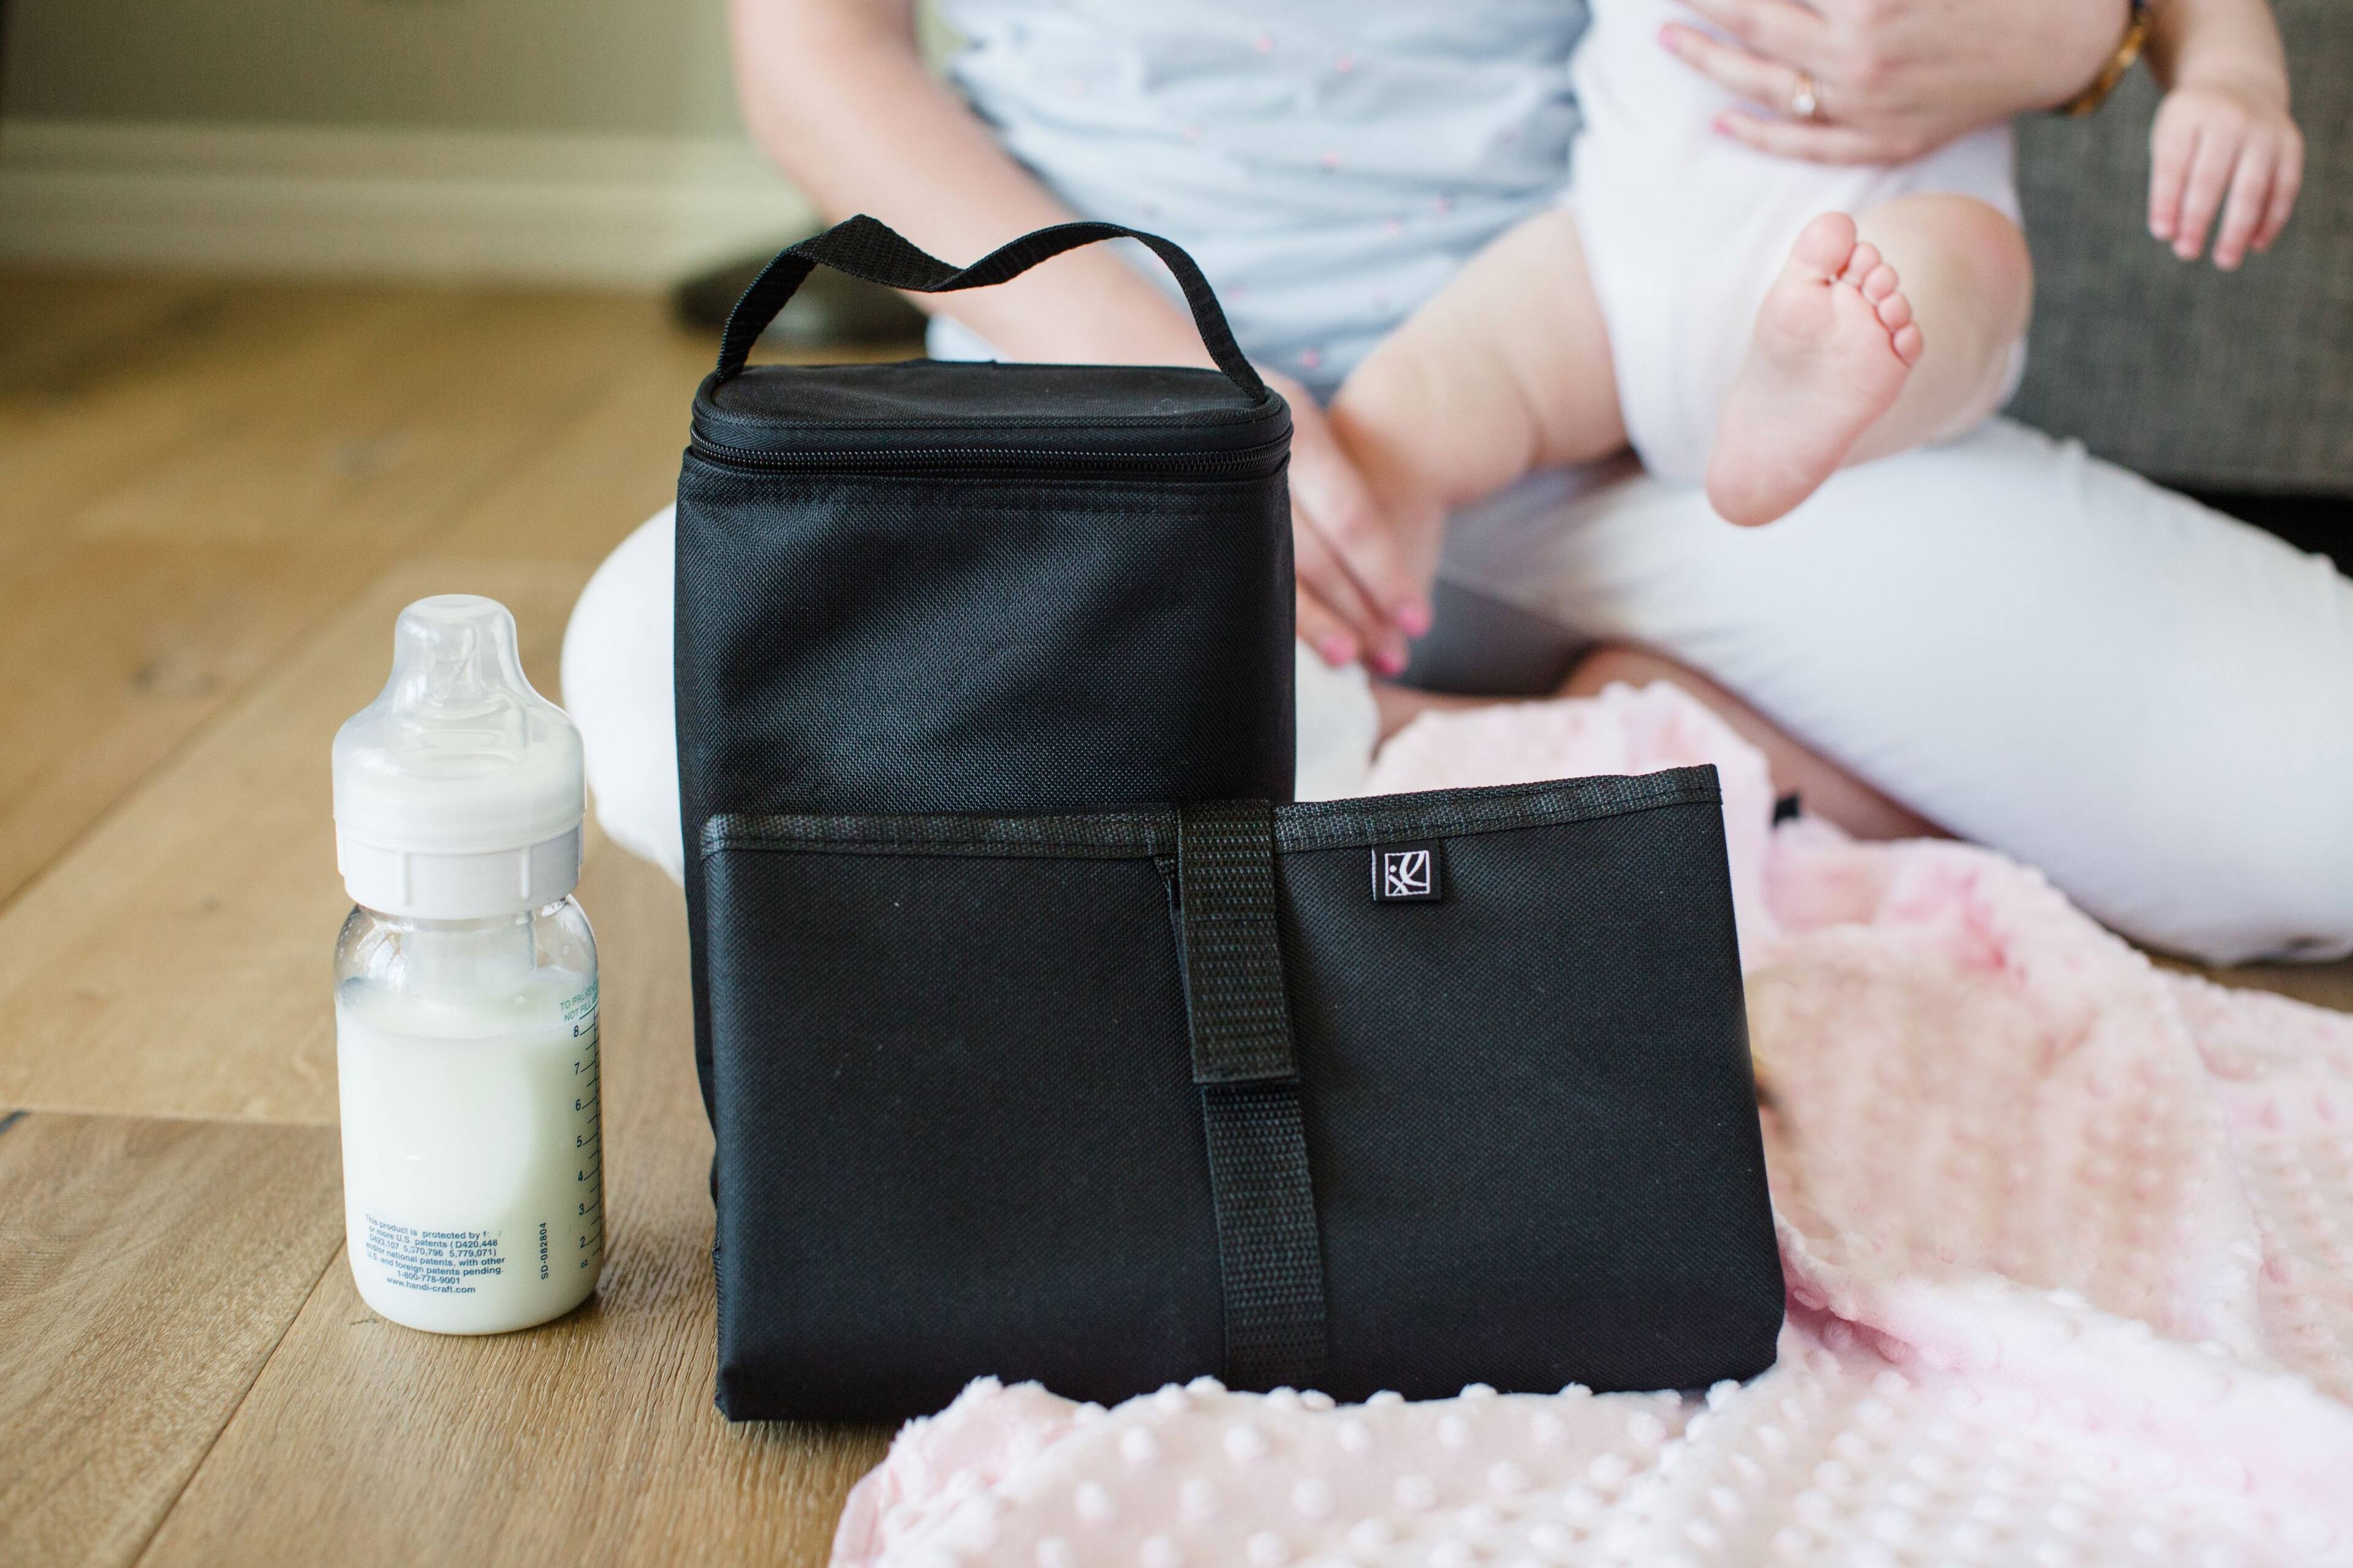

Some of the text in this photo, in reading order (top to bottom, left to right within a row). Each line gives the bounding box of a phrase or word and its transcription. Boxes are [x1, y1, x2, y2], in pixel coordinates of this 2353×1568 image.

[559, 1000, 571, 1010] TO
[564, 1008, 580, 1023] NOT
[574, 1025, 579, 1037] 8
[574, 1062, 580, 1075] 7
[575, 1099, 581, 1111] 6
[577, 1135, 582, 1148] 5
[578, 1170, 583, 1182] 4
[578, 1203, 585, 1216] 3
[366, 1213, 377, 1225] This
[380, 1221, 407, 1234] product
[469, 1231, 480, 1240] by
[369, 1233, 399, 1249] D423,107
[450, 1248, 496, 1258] 5,779,071)
[377, 1229, 394, 1240] more
[415, 1239, 447, 1248] patents
[580, 1235, 585, 1249] 2
[539, 1222, 549, 1280] SD-082804
[387, 1251, 417, 1263] national
[420, 1258, 456, 1267] patents,
[459, 1258, 478, 1267] with
[481, 1257, 505, 1265] other
[381, 1257, 393, 1266] and
[395, 1260, 424, 1273] foreign
[426, 1267, 460, 1276] patents
[463, 1267, 504, 1277] pending.
[397, 1270, 460, 1284] 1-800-778-9001
[387, 1276, 476, 1293] www.handi-craft.com
